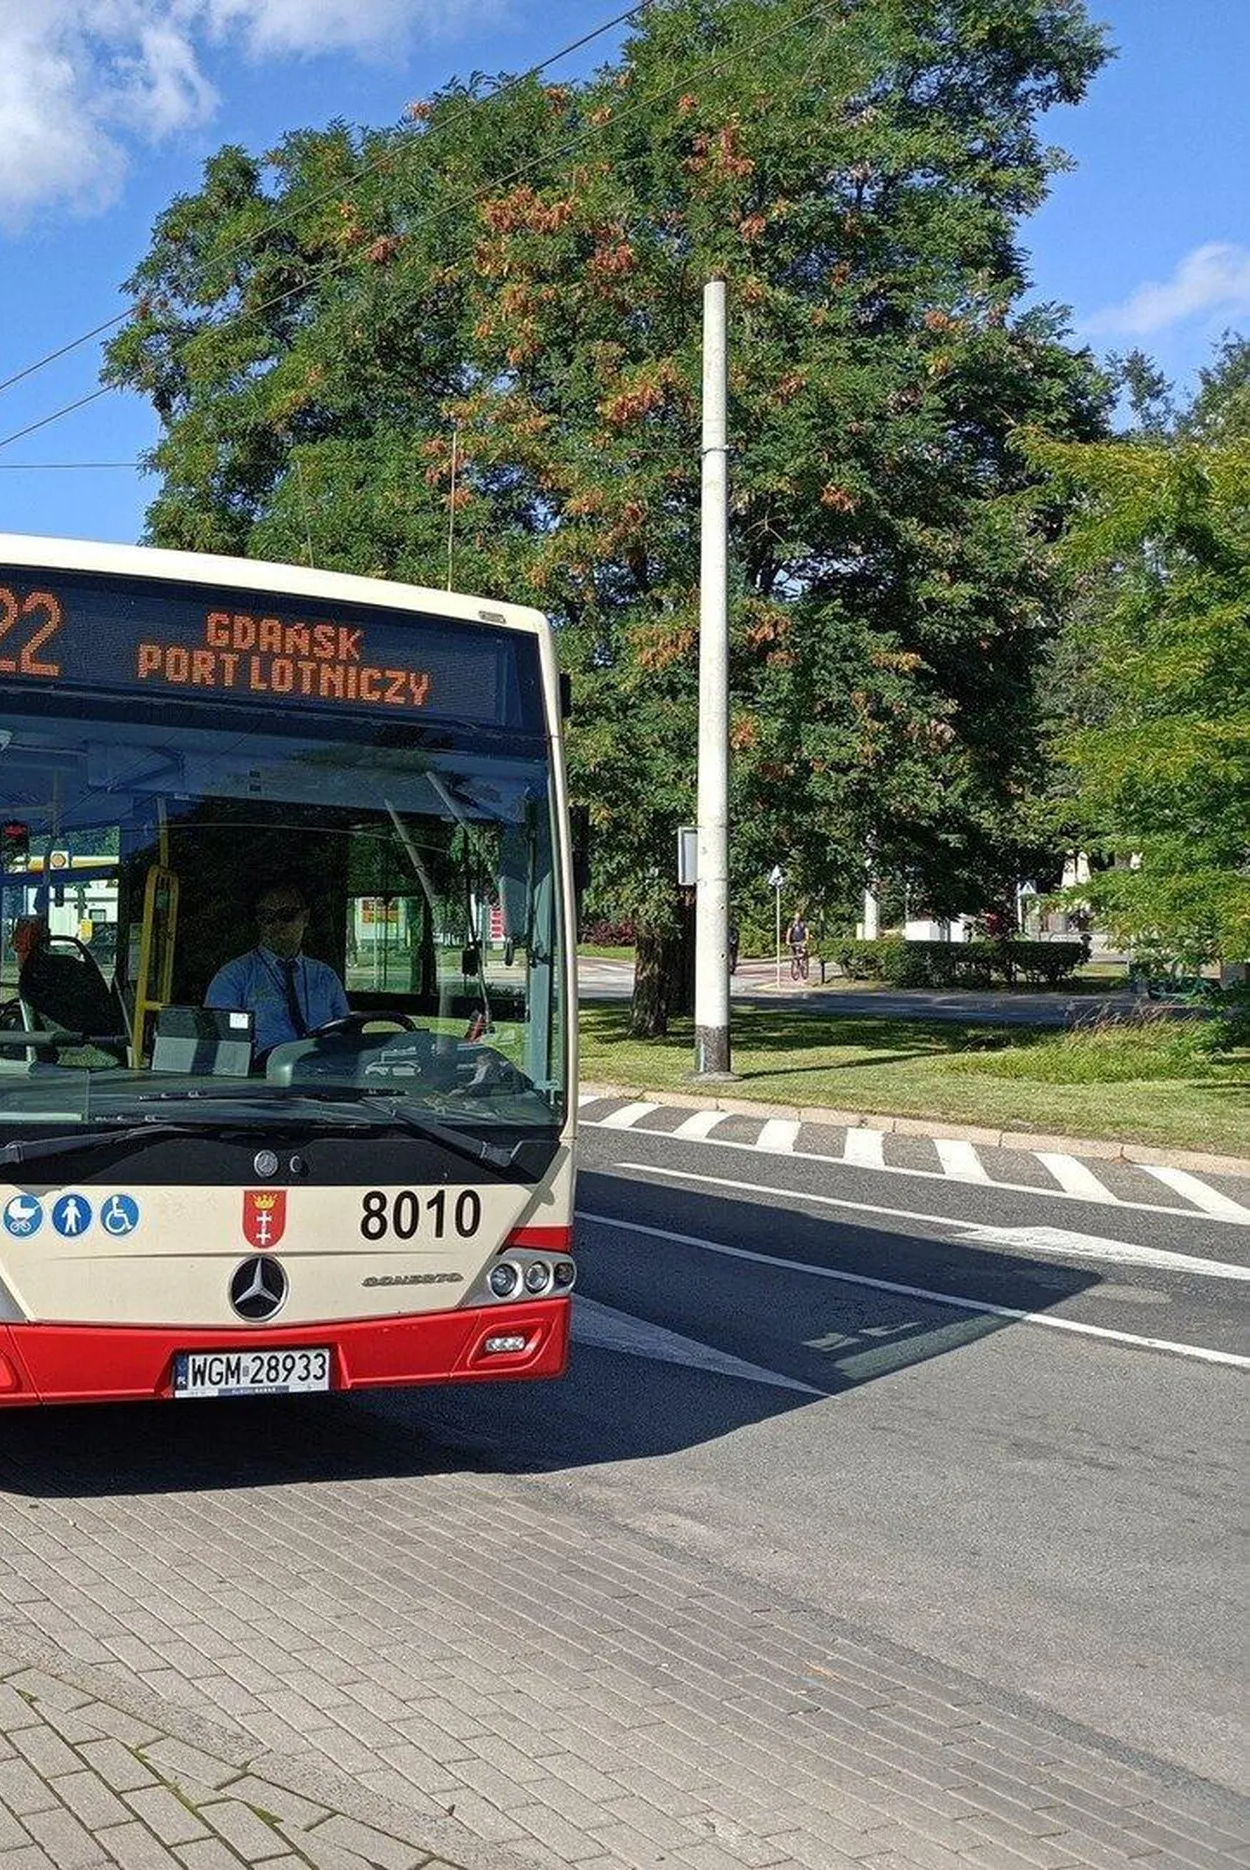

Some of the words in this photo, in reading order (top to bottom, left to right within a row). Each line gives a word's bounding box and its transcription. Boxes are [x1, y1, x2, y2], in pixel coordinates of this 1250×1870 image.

[206, 611, 364, 661] GDAŃSK
[138, 643, 240, 688] PORT
[250, 655, 430, 706] LOTNICZY
[360, 1188, 482, 1241] 8010
[191, 1356, 242, 1387] WGM
[250, 1352, 327, 1385] 28933
